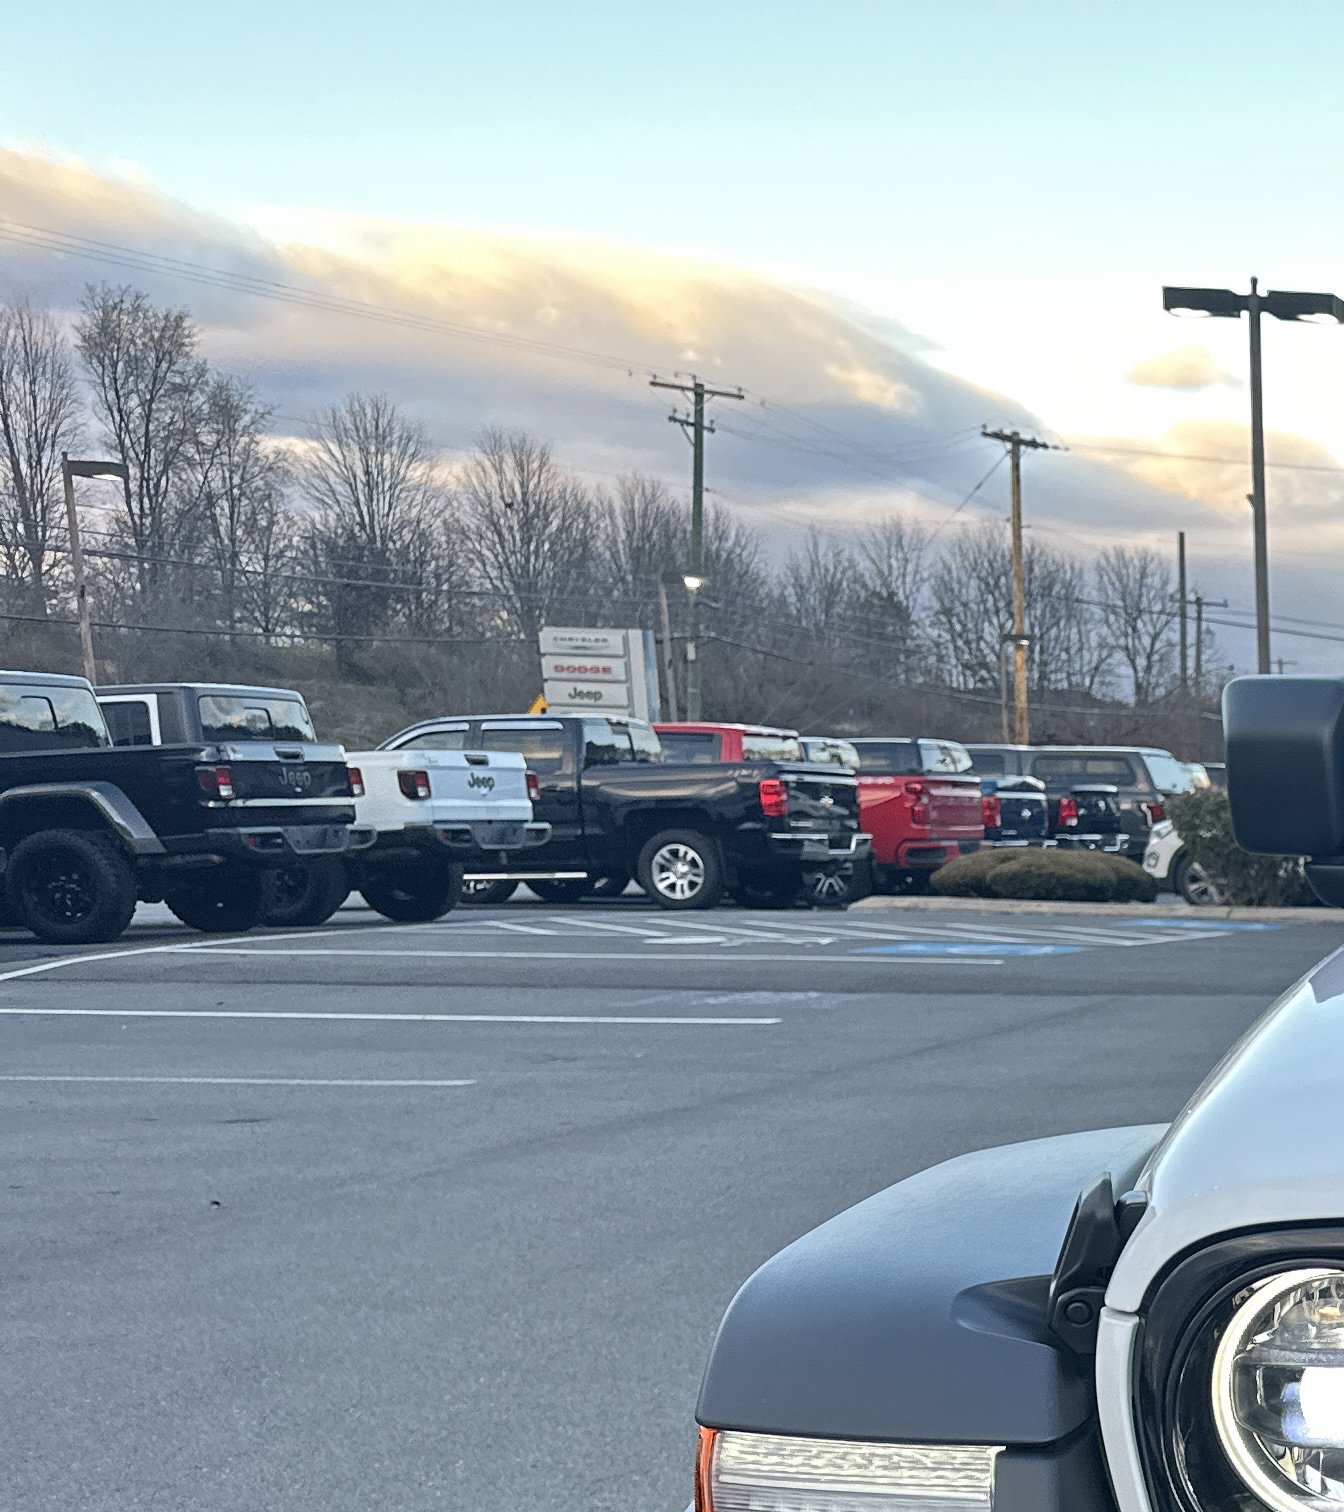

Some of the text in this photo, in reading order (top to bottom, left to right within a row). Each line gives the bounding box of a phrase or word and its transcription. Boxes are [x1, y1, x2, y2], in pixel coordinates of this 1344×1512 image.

[552, 636, 609, 644] CHRYSLER
[553, 664, 613, 675] DODGE
[567, 686, 604, 703] Jeep
[278, 767, 311, 788] Jeep
[467, 772, 495, 791] Jeep
